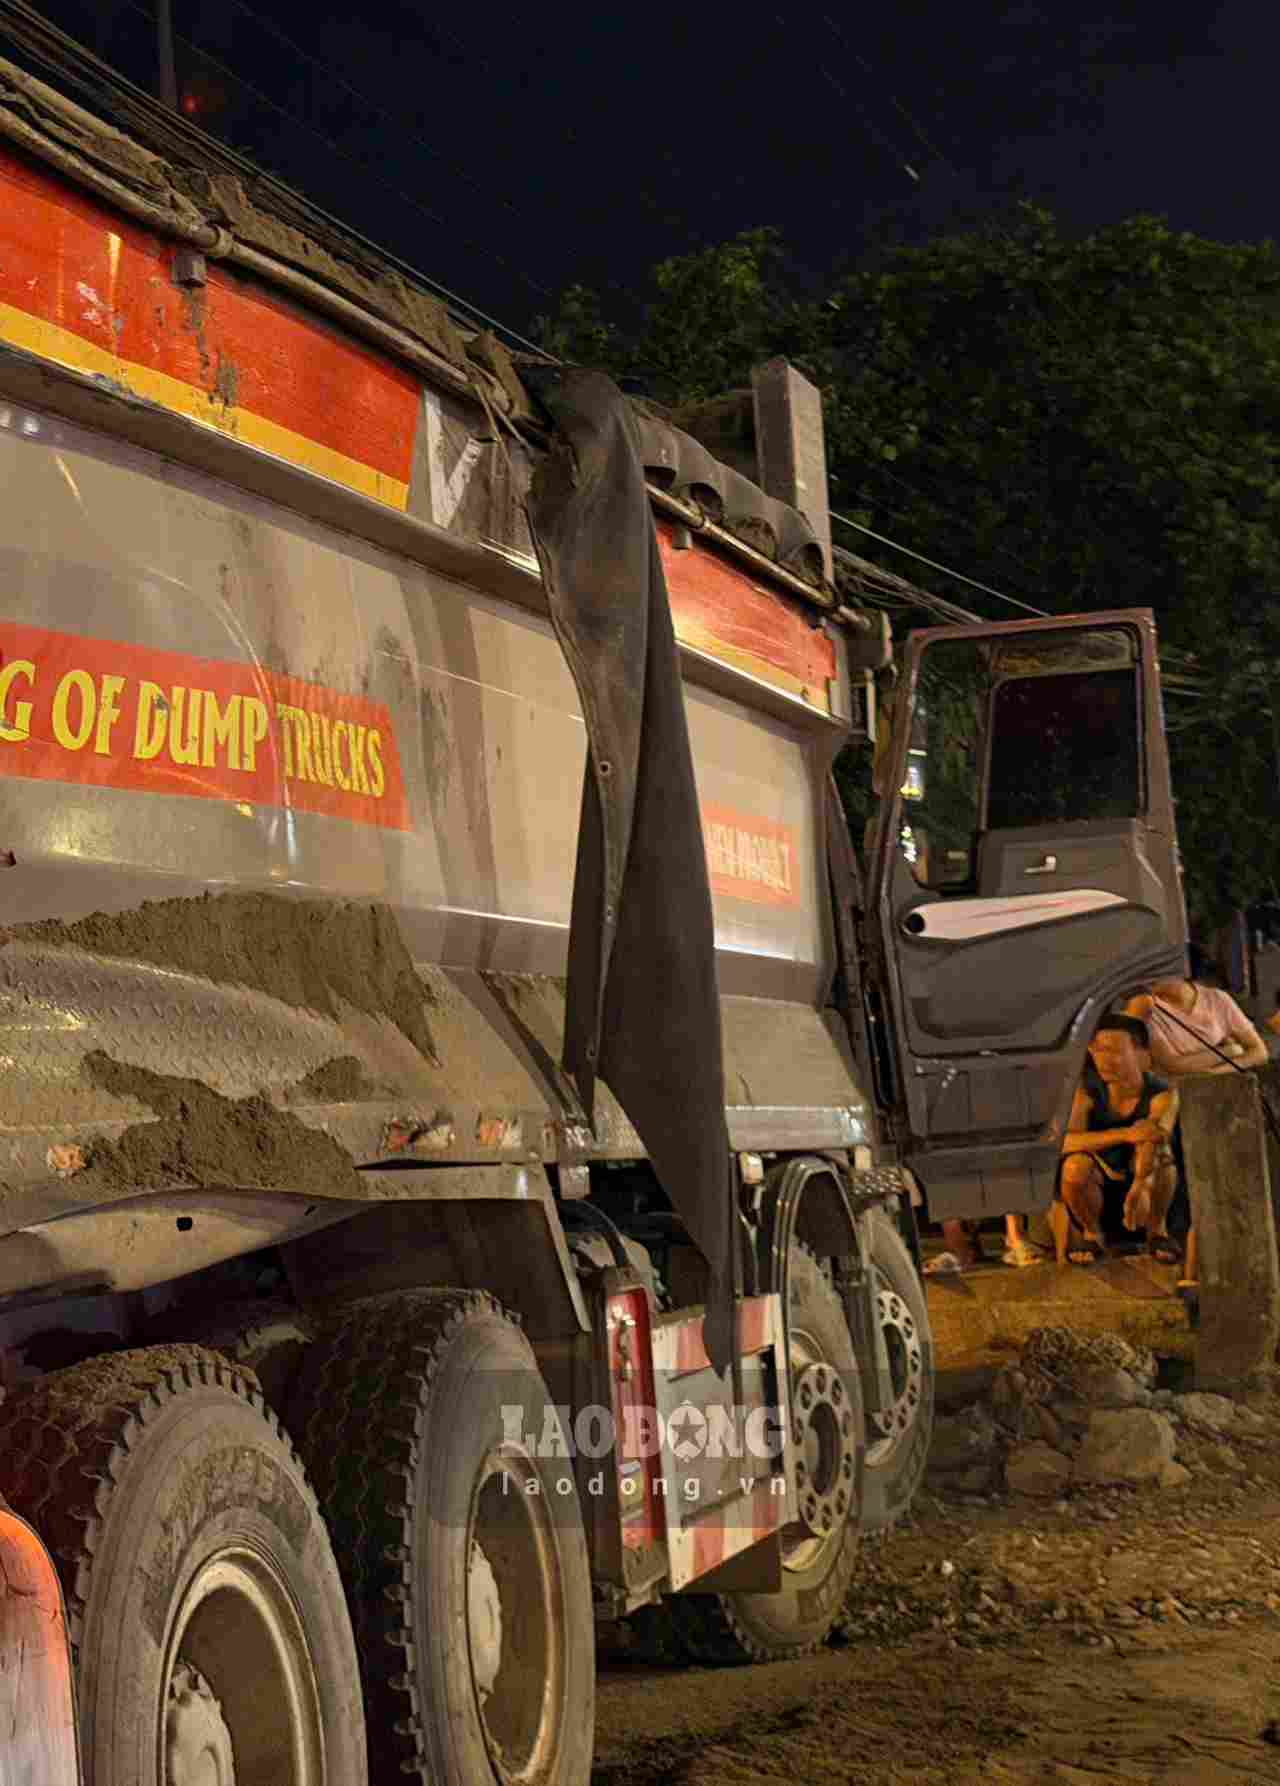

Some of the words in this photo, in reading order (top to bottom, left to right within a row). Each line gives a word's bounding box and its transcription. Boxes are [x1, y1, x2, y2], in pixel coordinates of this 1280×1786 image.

[52, 669, 126, 755] OF
[133, 680, 269, 771] DUMP
[276, 702, 385, 797] TRUCKS
